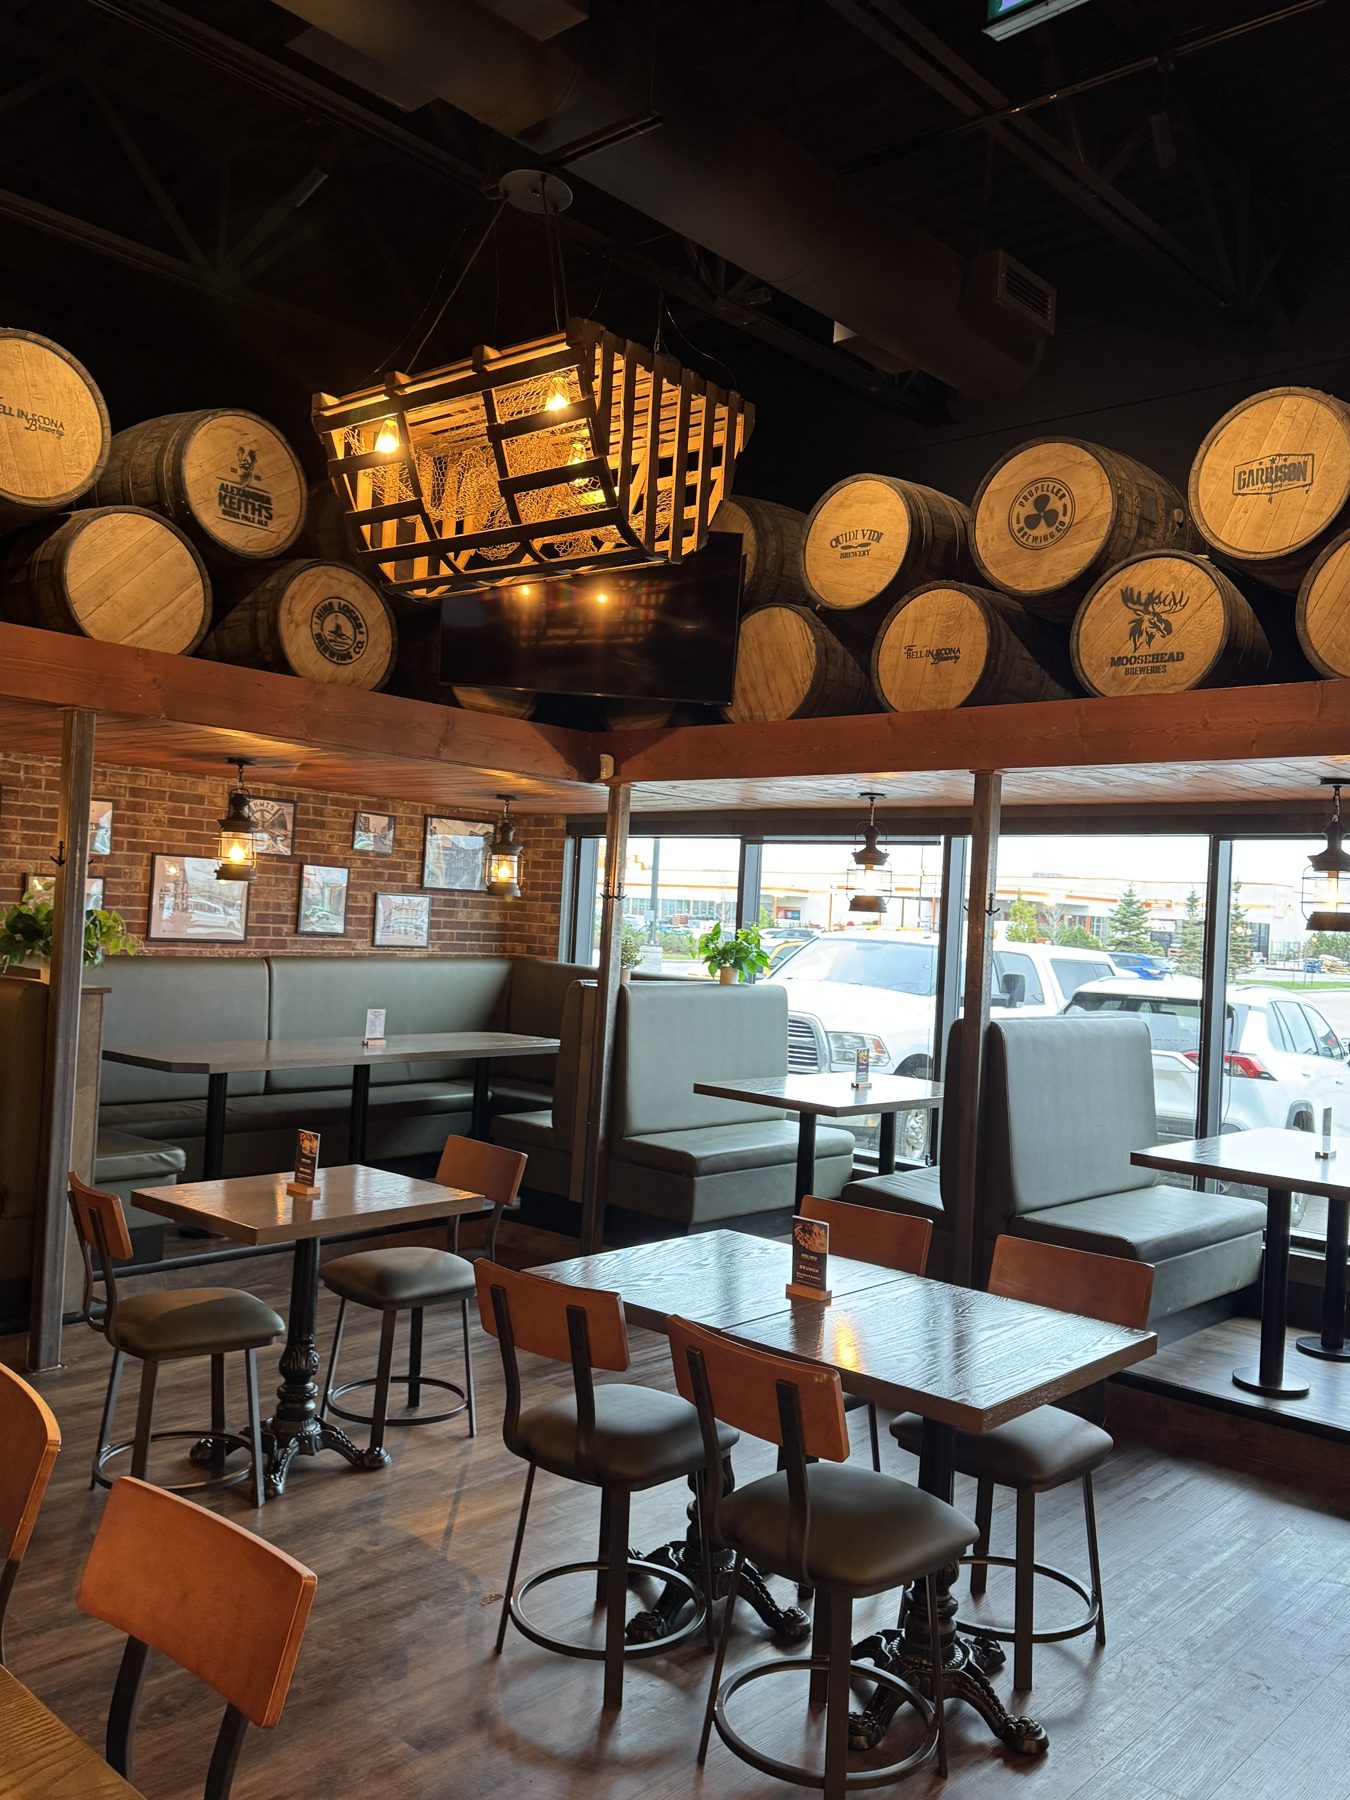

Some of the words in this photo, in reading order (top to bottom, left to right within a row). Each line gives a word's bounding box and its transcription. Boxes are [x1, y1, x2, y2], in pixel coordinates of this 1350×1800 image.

[0, 403, 14, 417] ELL
[1237, 460, 1308, 491] GARRISON
[1018, 483, 1067, 508] PROPELLER
[830, 529, 859, 549] QUIDI
[861, 528, 884, 544] VIDI
[1016, 526, 1055, 544] BREWING
[1110, 651, 1185, 668] MOOSEHEAD
[1124, 664, 1168, 677] BREWERIES
